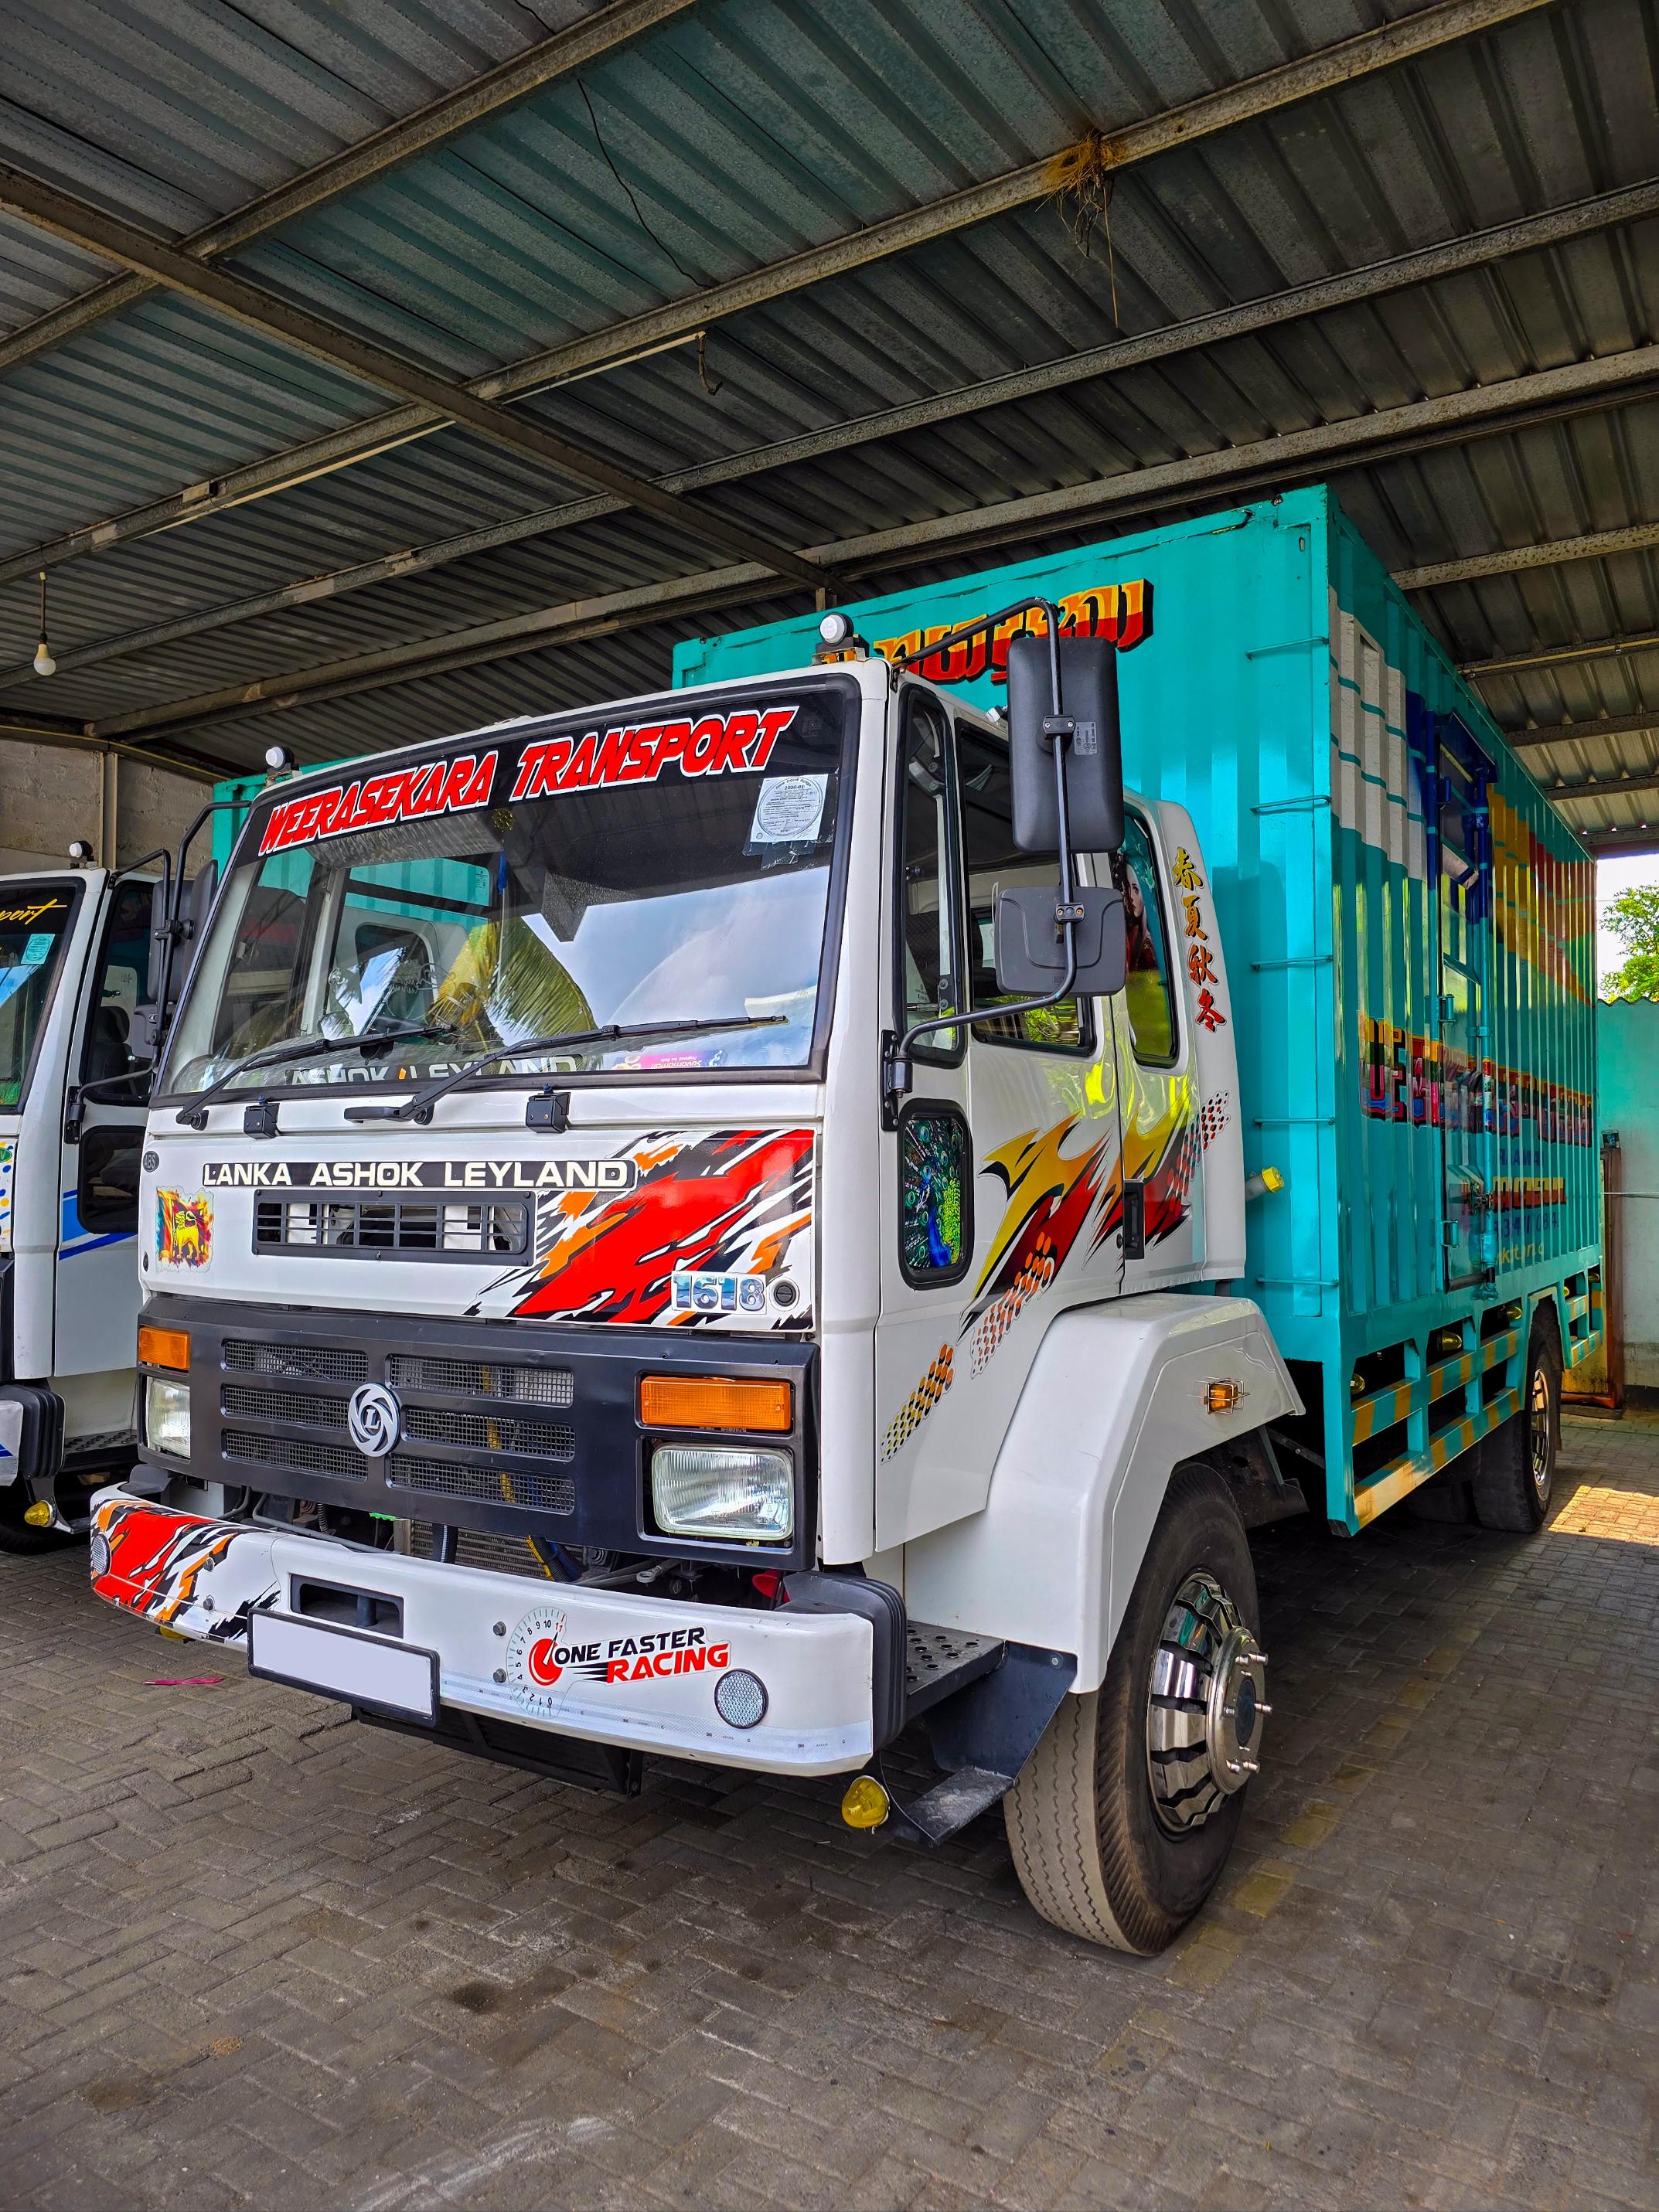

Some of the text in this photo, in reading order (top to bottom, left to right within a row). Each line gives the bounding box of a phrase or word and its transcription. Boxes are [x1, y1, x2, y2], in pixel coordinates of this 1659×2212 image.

[258, 706, 799, 856] WEERASEKARA TRANSPORT
[1172, 846, 1226, 1033] 春夏秋冬
[144, 1154, 156, 1169] ABS
[203, 1161, 628, 1187] LANKA ASHOK LEYLAND
[673, 1274, 765, 1312] 1618
[364, 1408, 381, 1430] L
[527, 1627, 533, 1635] 8
[536, 1621, 540, 1629] 9
[543, 1619, 552, 1628] 10
[555, 1622, 564, 1633] 11
[520, 1636, 526, 1645] 7
[554, 1626, 705, 1665] ONE FASTER
[607, 1642, 729, 1684] RACING
[529, 1693, 535, 1702] 2
[548, 1696, 553, 1707] 0
